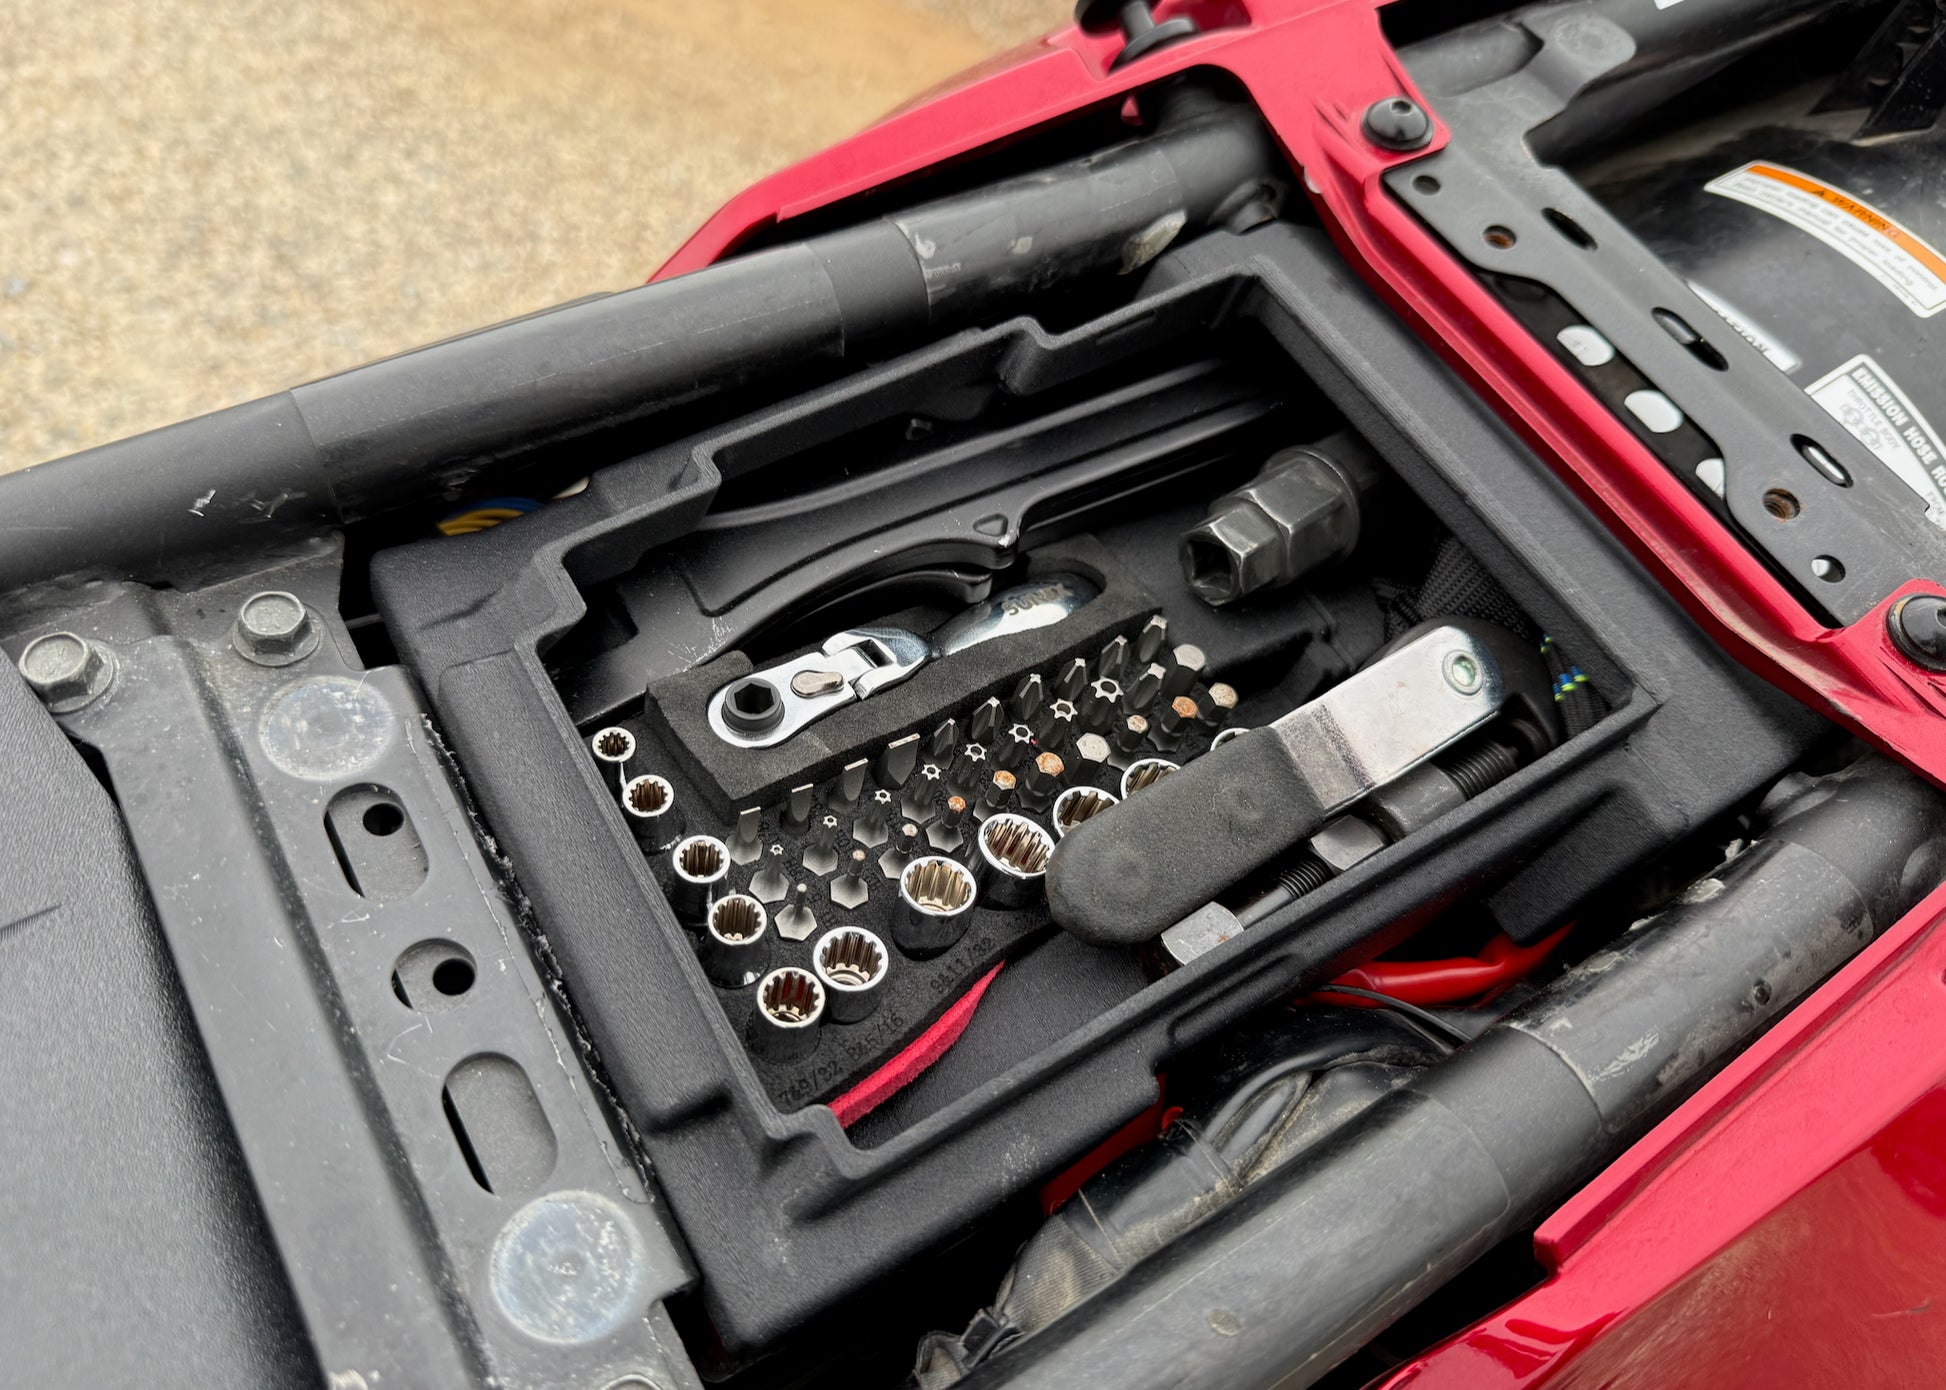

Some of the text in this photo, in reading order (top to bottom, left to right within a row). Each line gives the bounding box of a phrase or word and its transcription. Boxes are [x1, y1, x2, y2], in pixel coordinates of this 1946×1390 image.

[1834, 196, 1901, 239] WARNING
[1847, 388, 1884, 428] THROTTLE
[1851, 367, 1909, 427] EMISSION
[1903, 425, 1938, 465] HOSE
